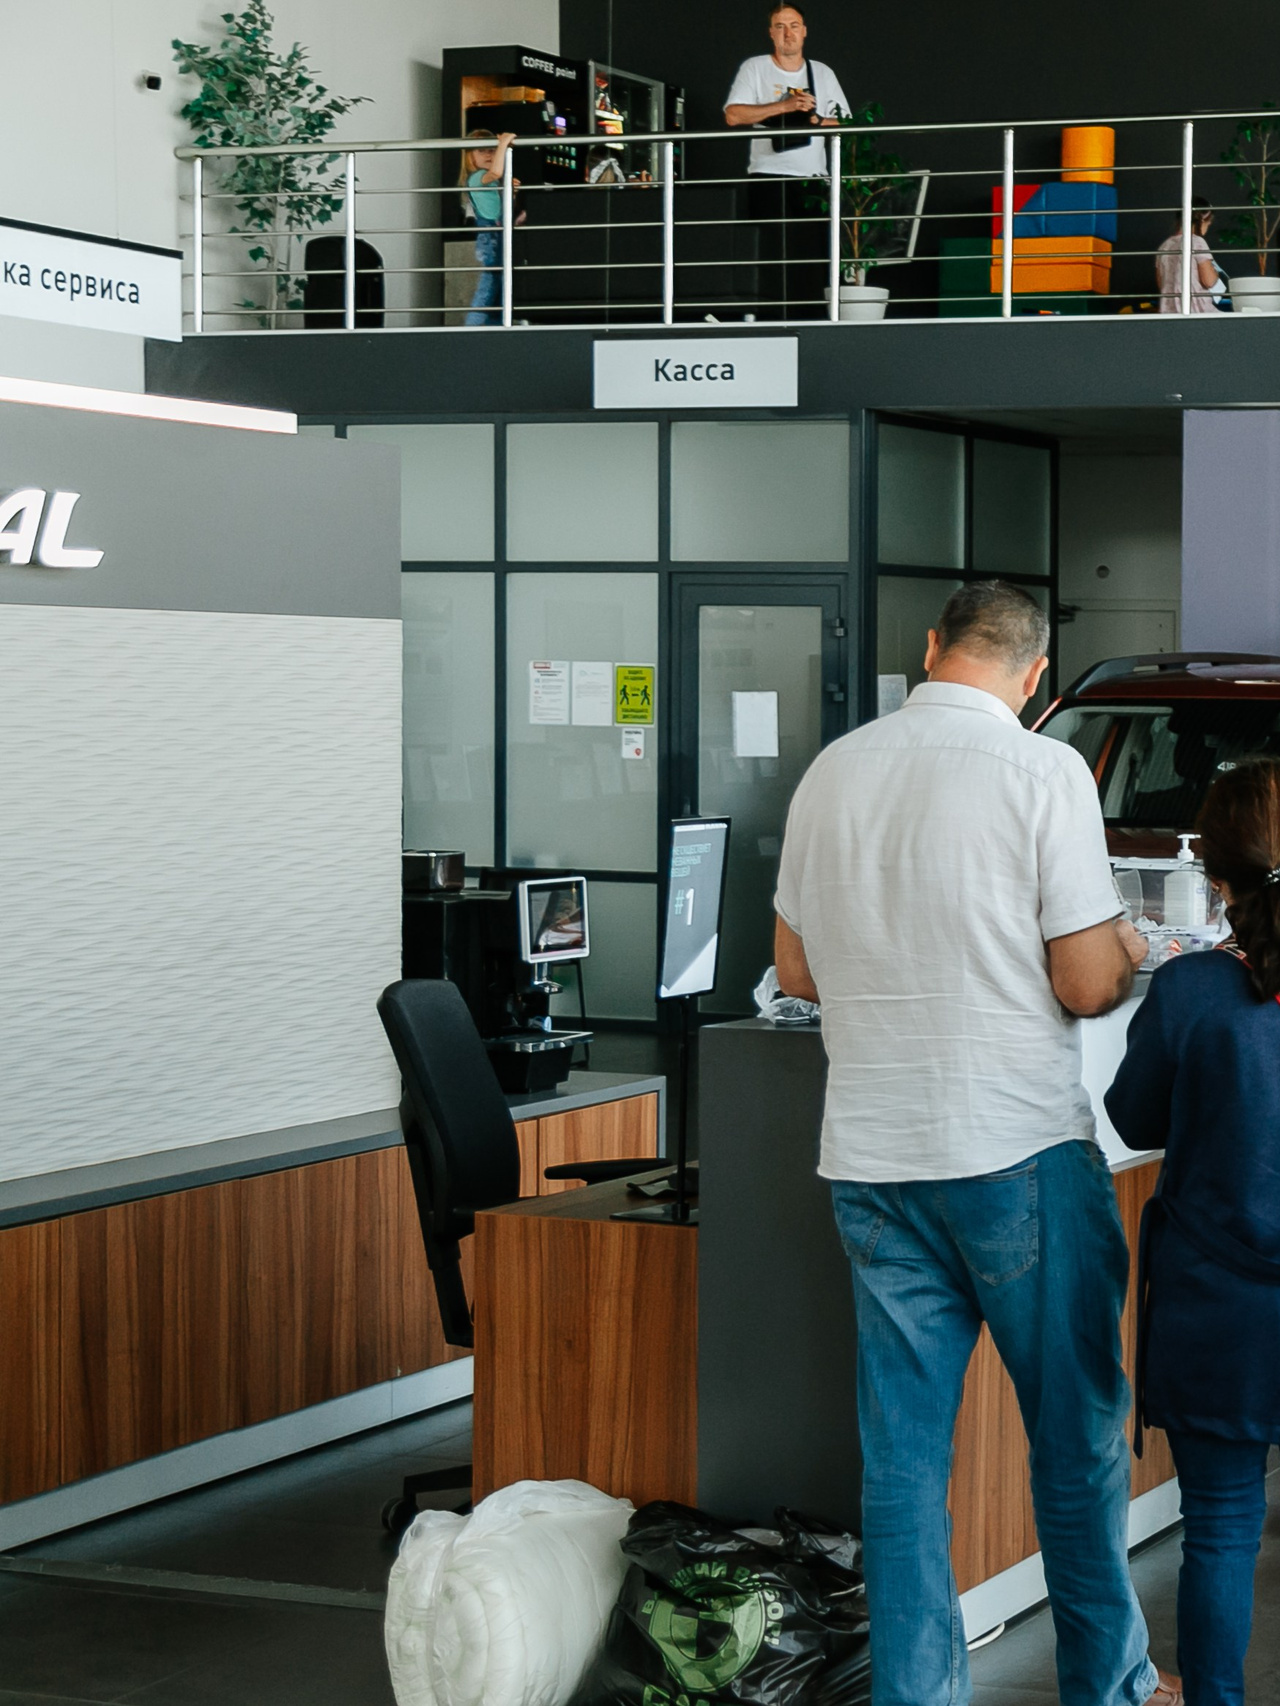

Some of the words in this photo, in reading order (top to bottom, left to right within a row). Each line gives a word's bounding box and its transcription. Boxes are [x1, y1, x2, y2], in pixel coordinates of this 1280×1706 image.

[522, 55, 554, 74] COFFEE
[555, 67, 576, 80] point
[4, 261, 31, 287] ка
[41, 267, 140, 304] сервиса
[654, 358, 735, 382] Касса
